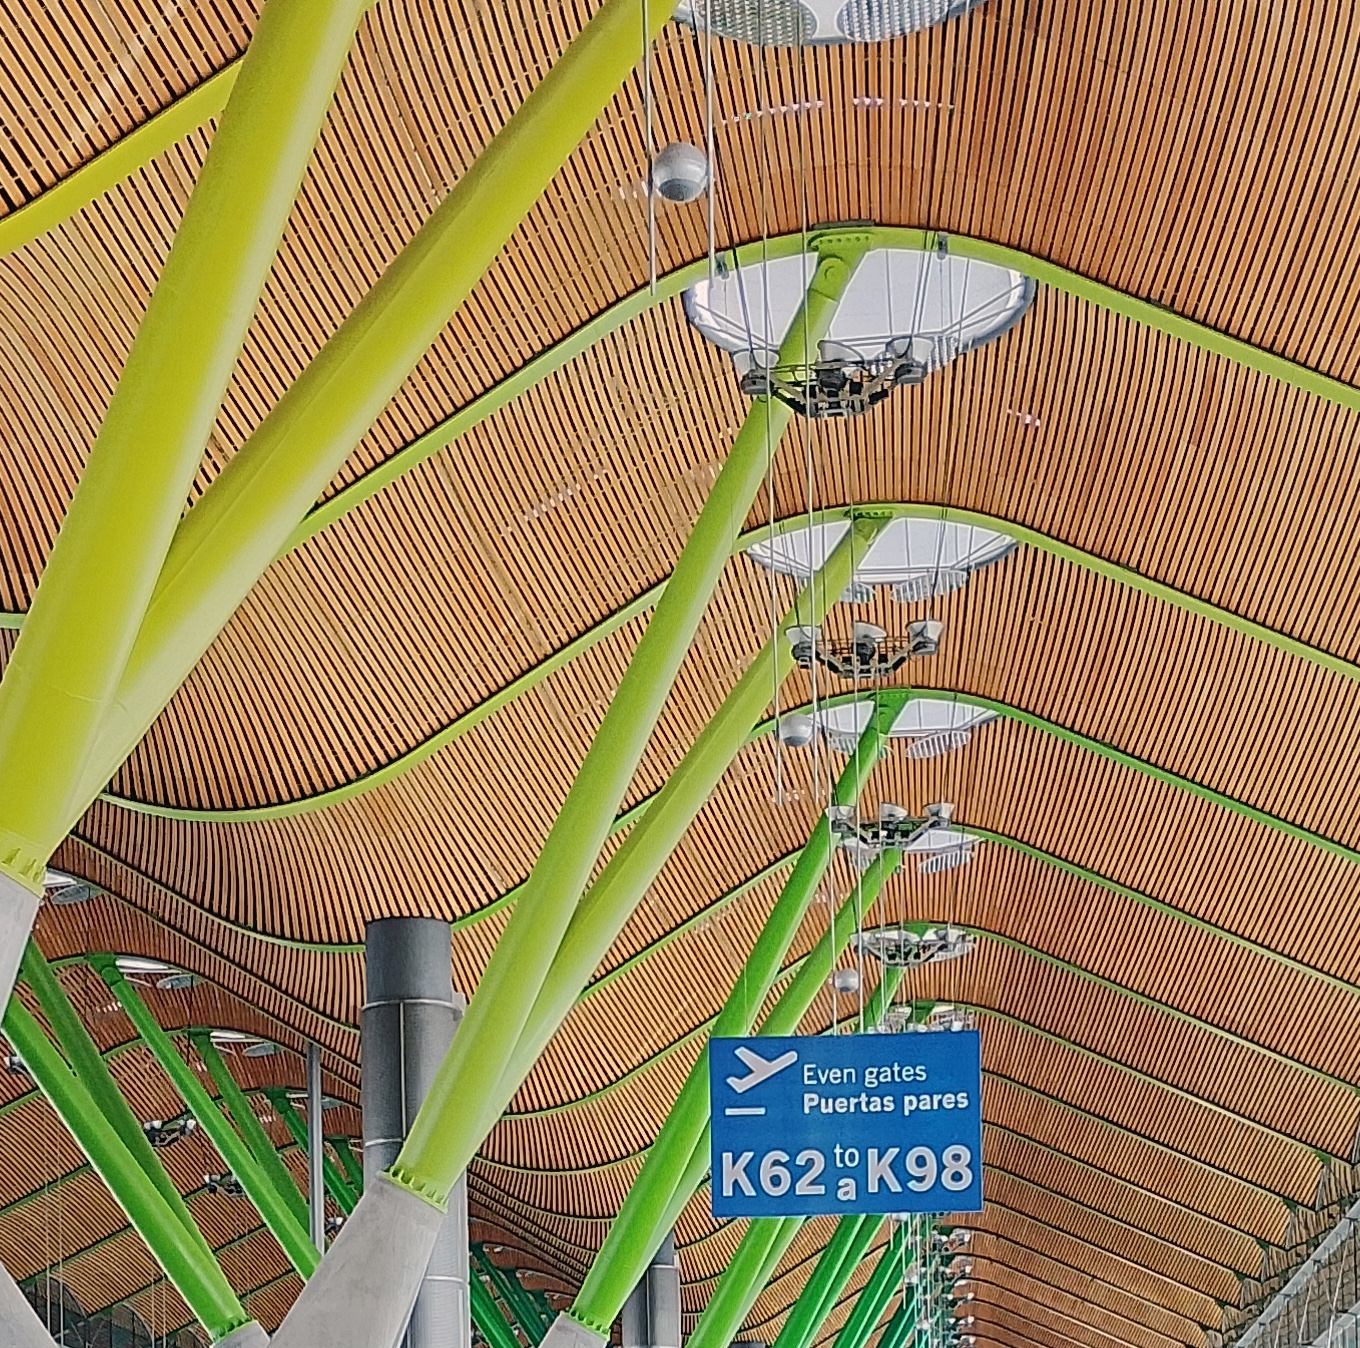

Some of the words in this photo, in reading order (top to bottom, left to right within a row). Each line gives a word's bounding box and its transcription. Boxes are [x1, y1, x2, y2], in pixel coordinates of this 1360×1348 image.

[803, 1064, 856, 1086] Even
[864, 1062, 928, 1088] gates
[803, 1093, 894, 1115] Puertas
[903, 1091, 969, 1116] pares
[721, 1149, 826, 1198] K62
[834, 1143, 859, 1168] to
[867, 1144, 973, 1193] K98
[837, 1177, 857, 1201] a
